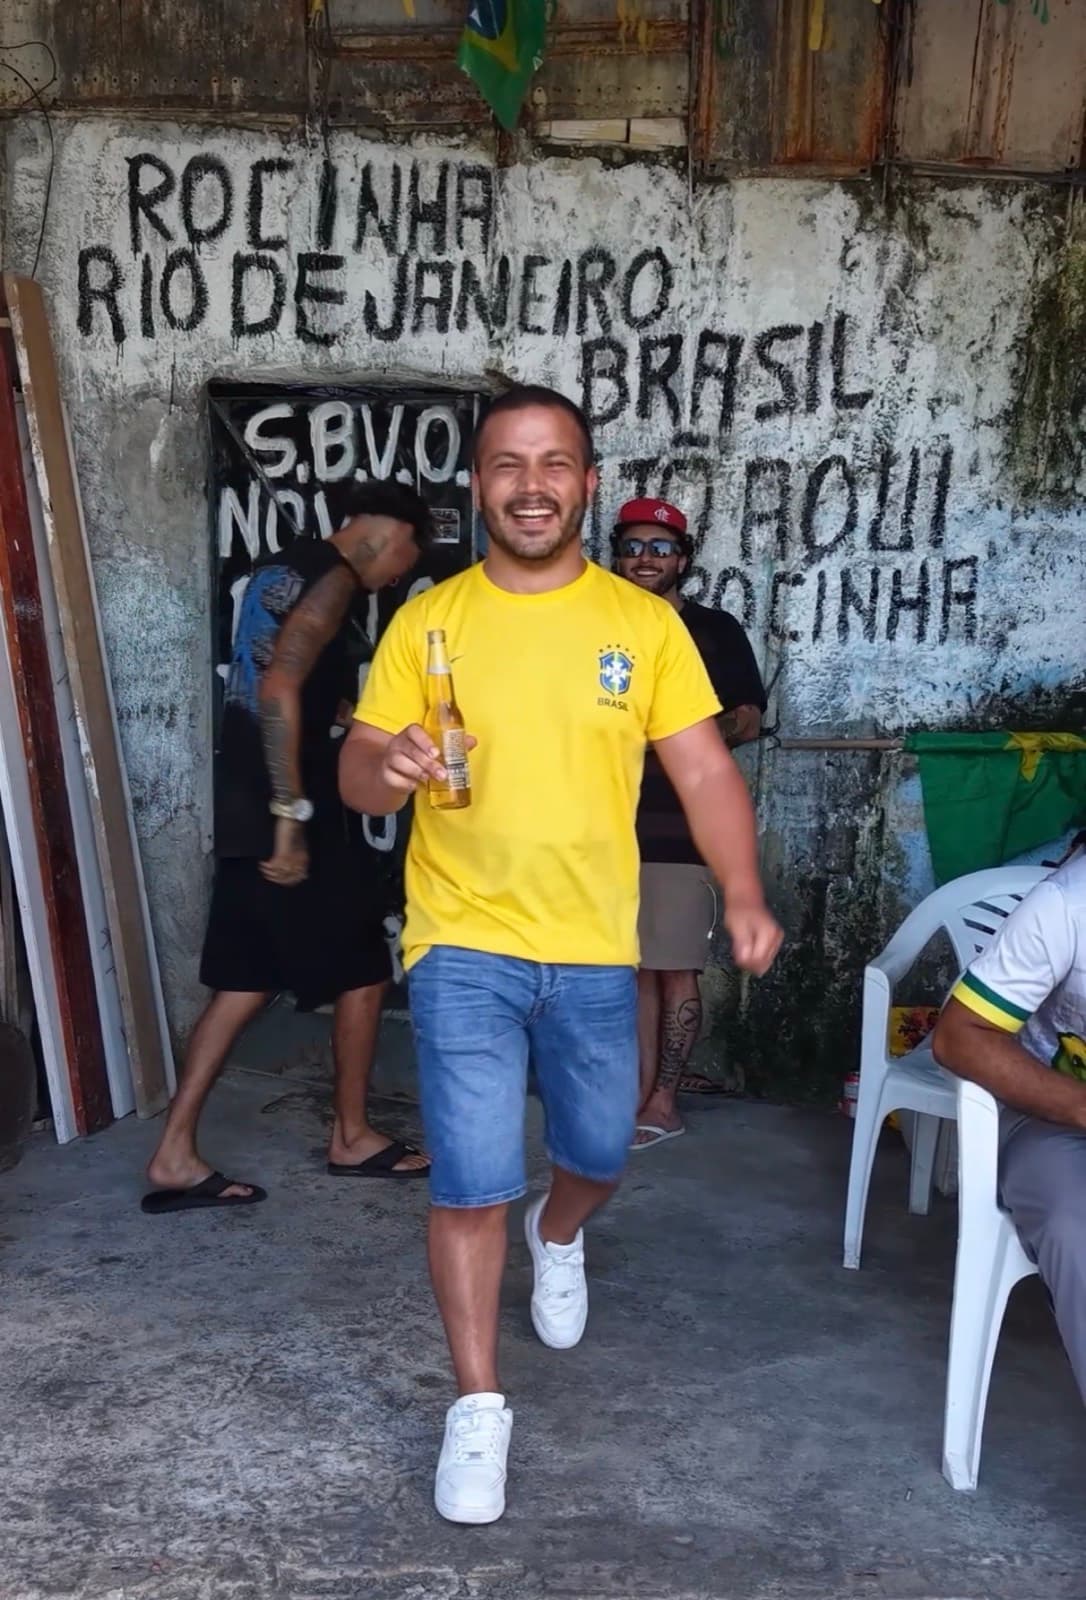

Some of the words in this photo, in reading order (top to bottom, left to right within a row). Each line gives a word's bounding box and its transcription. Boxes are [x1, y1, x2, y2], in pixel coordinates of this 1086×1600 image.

[126, 153, 493, 260] ROCINHA
[77, 246, 209, 345] RIO
[231, 251, 347, 346] DE
[363, 246, 673, 342] JANEIRO
[582, 310, 874, 430] BRASIL
[244, 401, 471, 490] S.B.V.O.
